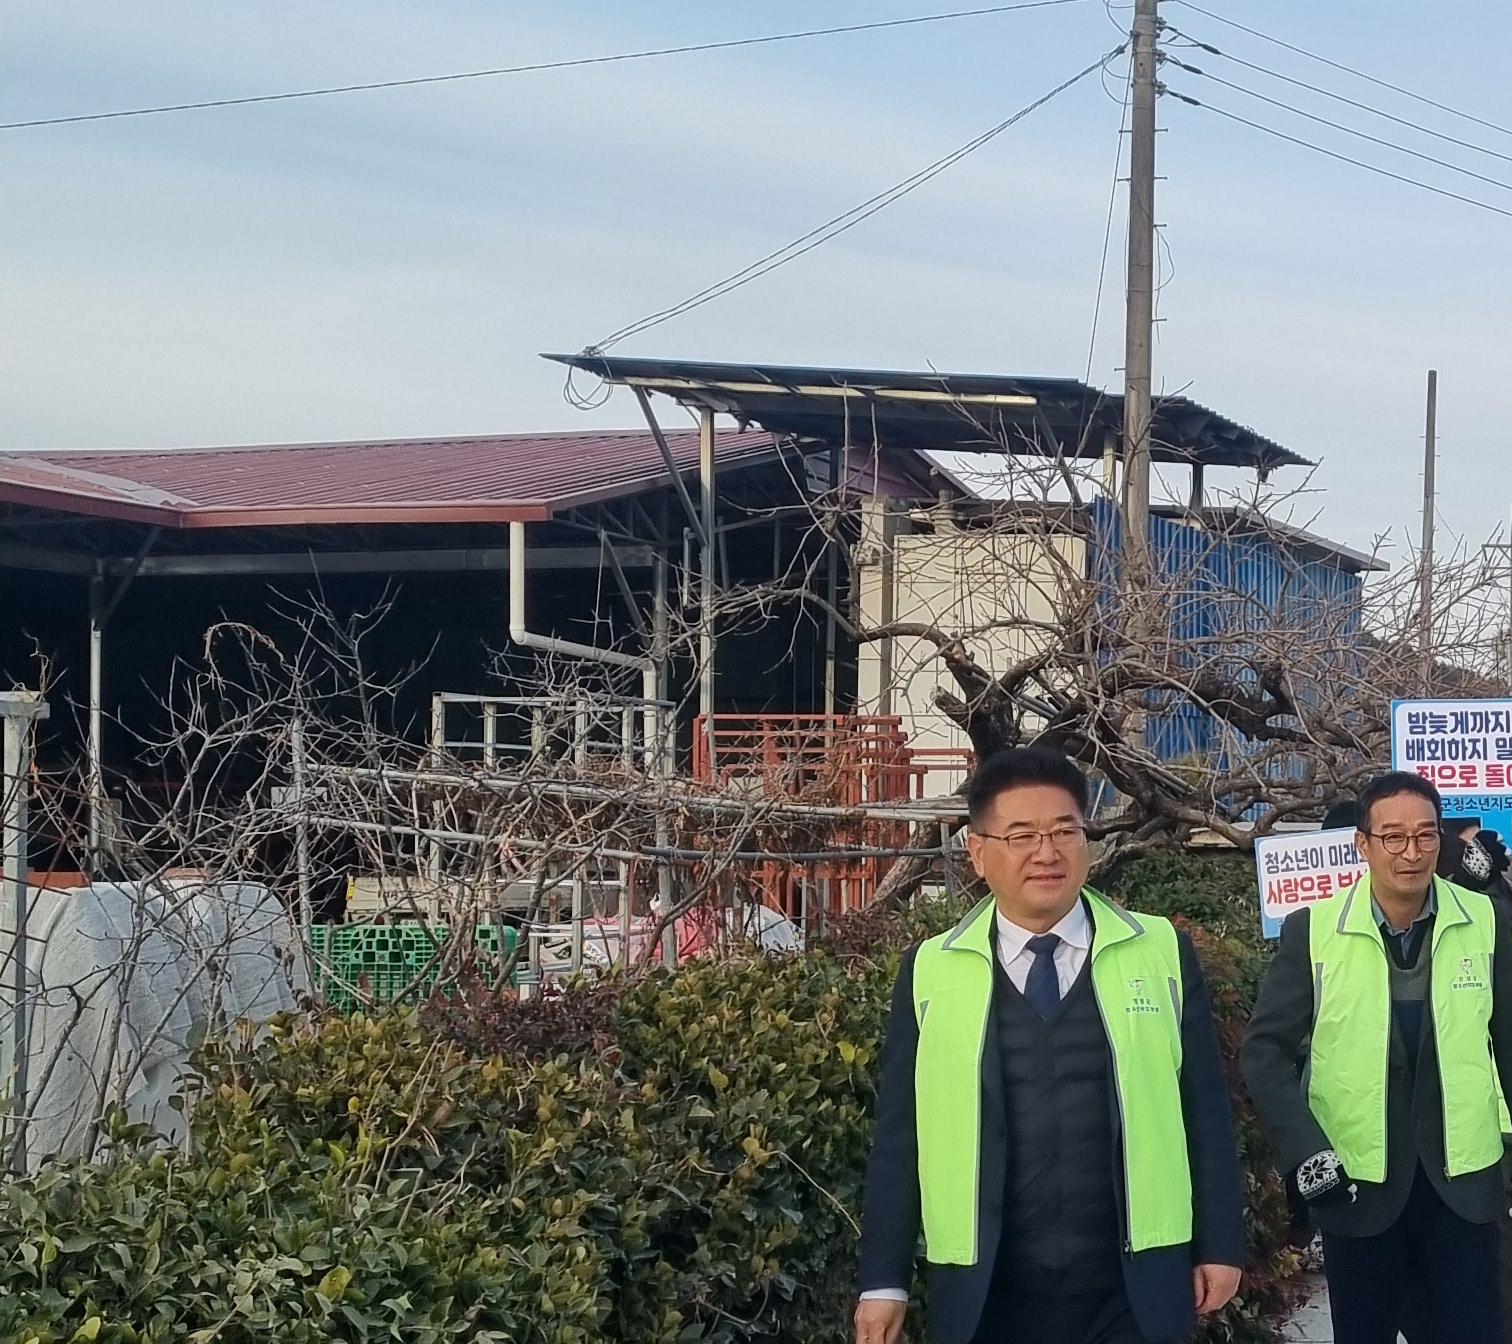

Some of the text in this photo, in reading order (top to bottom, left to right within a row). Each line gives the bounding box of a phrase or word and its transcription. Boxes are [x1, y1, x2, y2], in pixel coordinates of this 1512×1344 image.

[1408, 710, 1510, 735] 밤늦게까지
[1405, 737, 1488, 761] 배회하지
[1265, 842, 1368, 874] 청소년이 미래
[1266, 874, 1333, 904] 사랑으로
